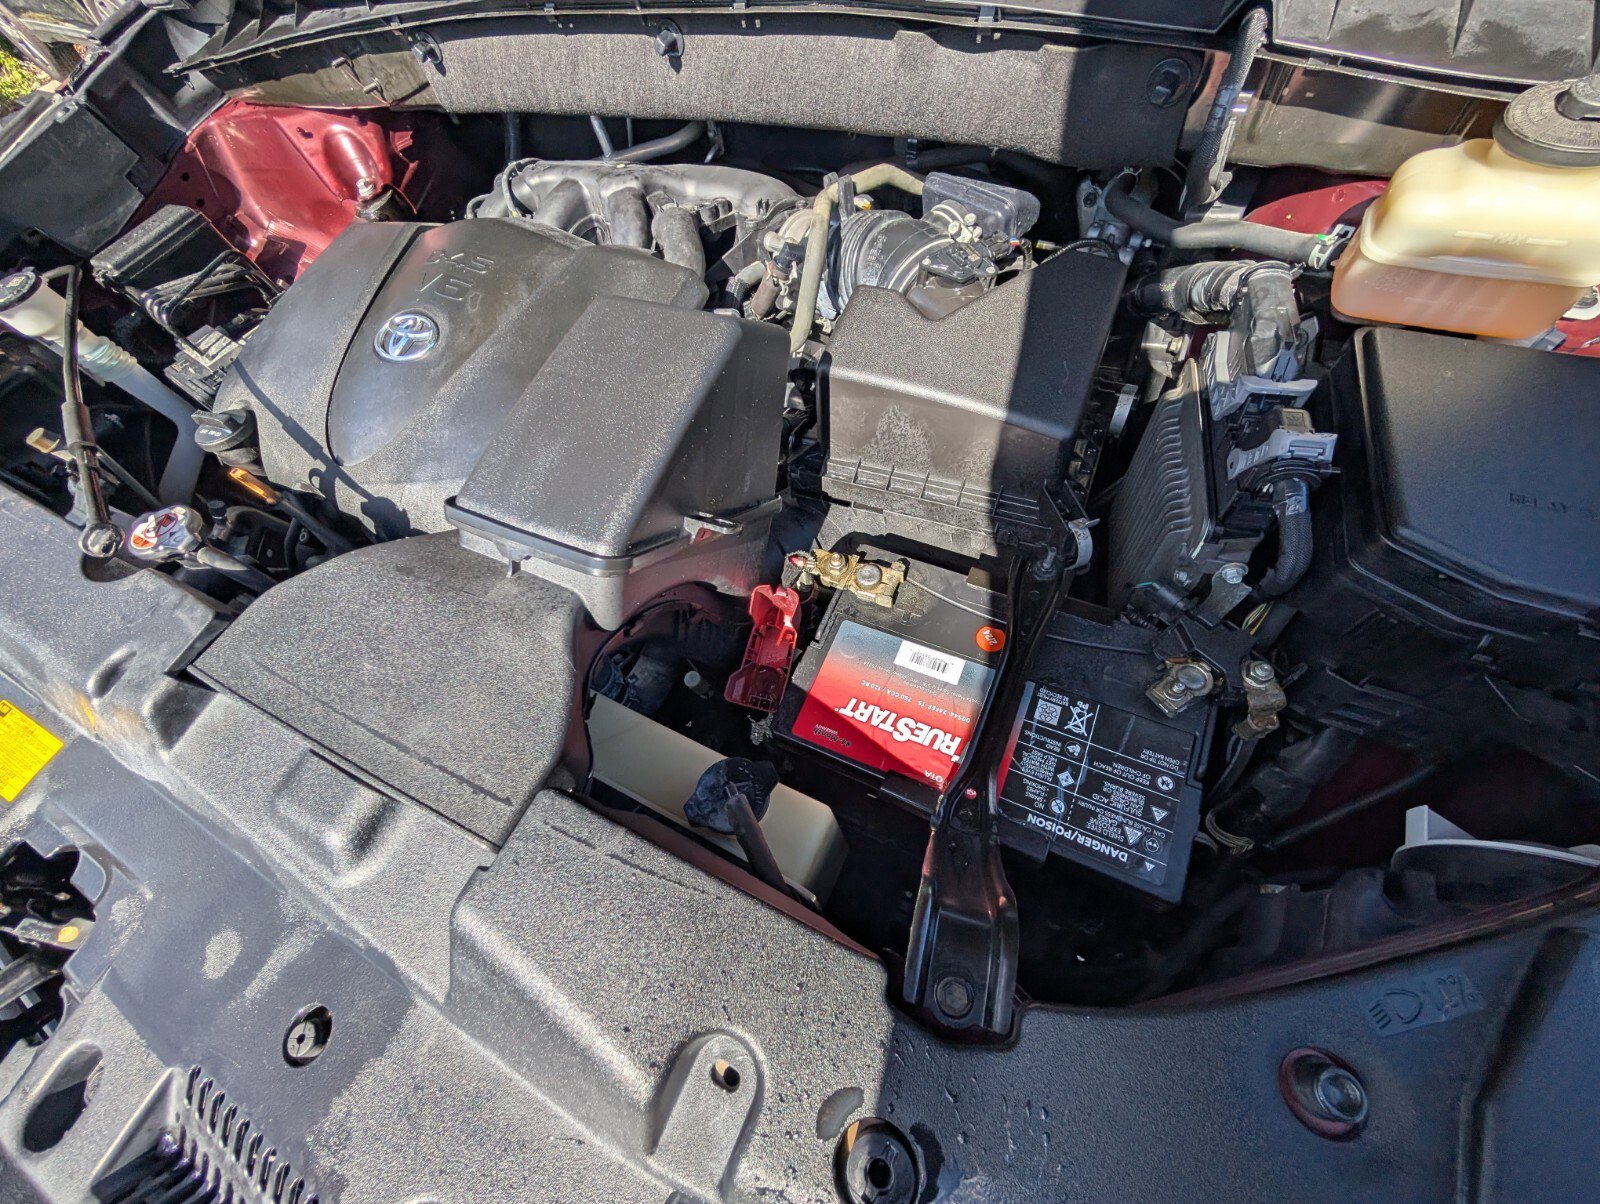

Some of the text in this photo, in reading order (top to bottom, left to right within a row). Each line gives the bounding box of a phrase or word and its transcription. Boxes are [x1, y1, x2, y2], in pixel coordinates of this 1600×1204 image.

[859, 678, 871, 687] RC
[869, 682, 882, 691] 120
[885, 688, 900, 698] CCA
[898, 693, 913, 702] 750
[1036, 691, 1068, 706] BATTERY MUST
[1038, 686, 1062, 699] RECYCLED
[1075, 699, 1089, 710] Pb
[834, 696, 962, 762] RUESTART
[1044, 742, 1060, 753] READ
[1021, 750, 1056, 767] GET MEDICAL
[1043, 753, 1057, 762] HELP
[1139, 752, 1179, 771] DO NOT TIP OR
[1163, 755, 1180, 766] OPEN
[1019, 759, 1054, 777] IMMEDIATELY
[1040, 762, 1055, 772] WITH
[1092, 759, 1150, 786] KEEP OUT OF REACH
[921, 769, 945, 784] OTA
[1034, 771, 1052, 782] FLUSH
[1141, 771, 1151, 780] OF
[1021, 777, 1046, 791] SMOKING
[1102, 785, 1144, 805] BLINDNESS OR
[1123, 787, 1146, 800] SEVERE
[1033, 800, 1044, 810] NO
[1091, 791, 1142, 817] SULFURIC ACID
[1109, 793, 1144, 811] CAN CAUSE
[1095, 806, 1104, 814] OR
[1096, 812, 1118, 826] GASES
[1104, 809, 1133, 826] BLINDNESS
[1088, 815, 1121, 834] EXPLOSIVE
[1133, 820, 1152, 833] CAUSE
[1025, 810, 1128, 863] DANGER/POISON
[1101, 827, 1124, 842] SHIELD
[1152, 828, 1166, 839] CAN
